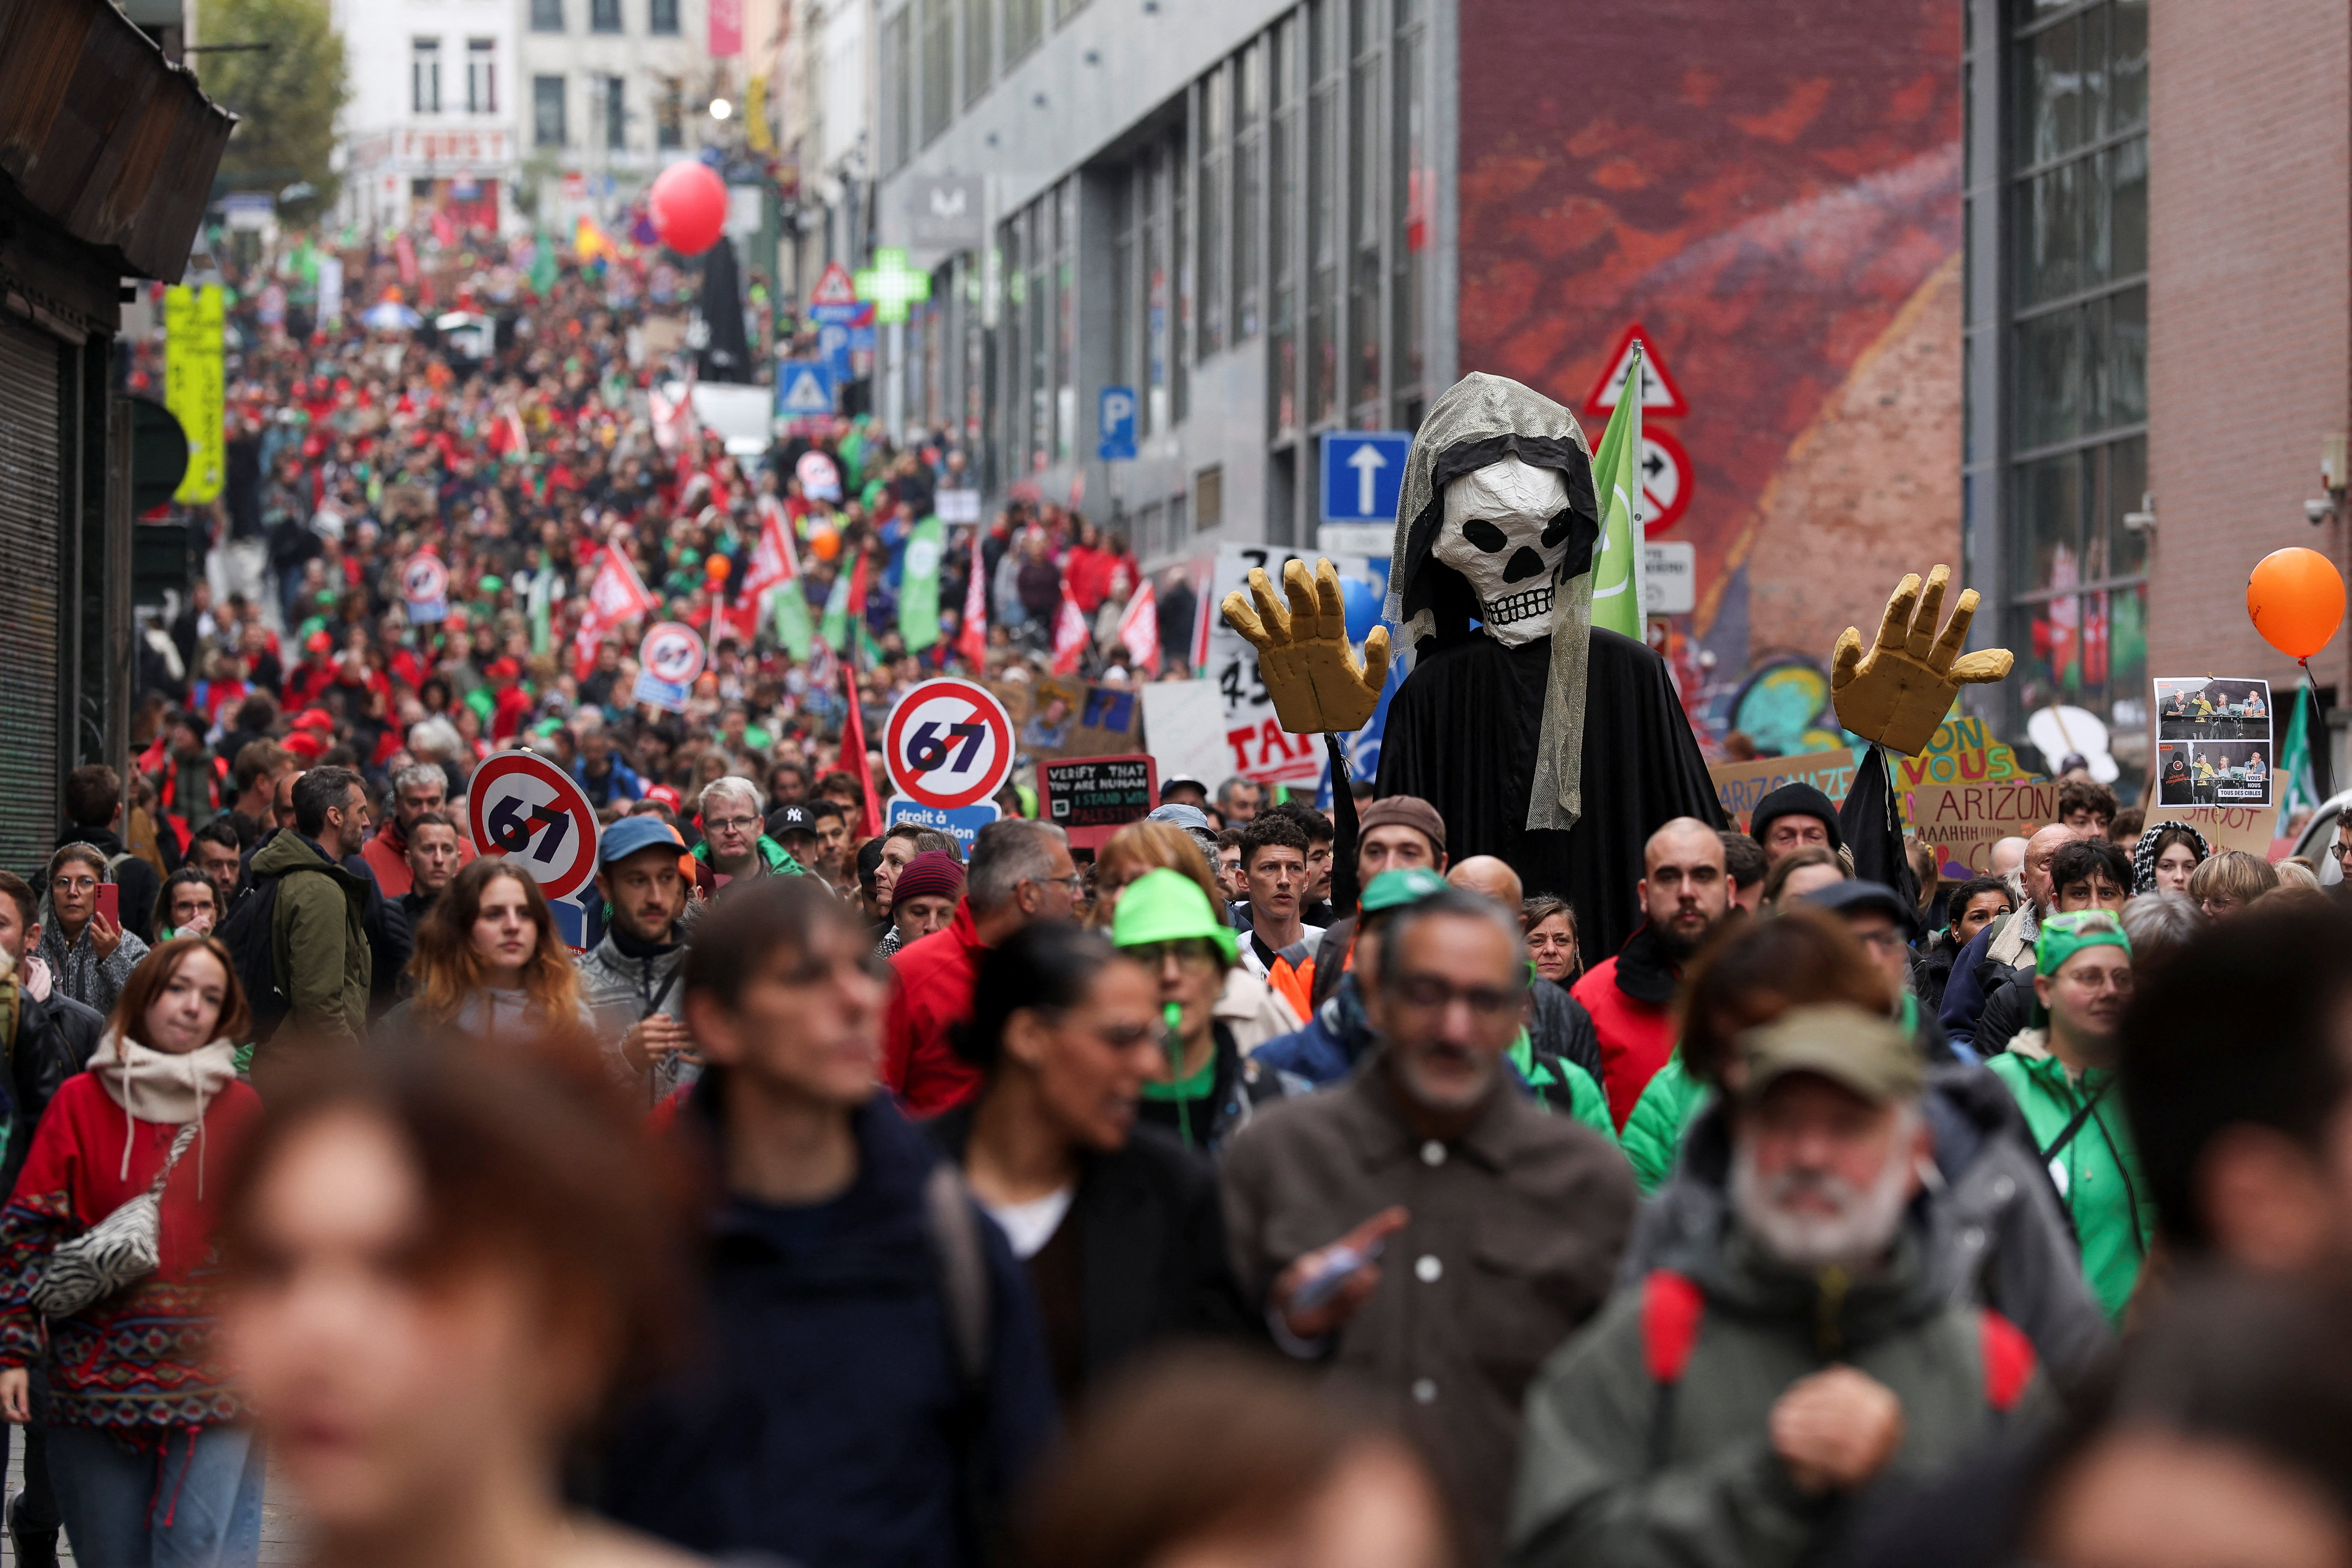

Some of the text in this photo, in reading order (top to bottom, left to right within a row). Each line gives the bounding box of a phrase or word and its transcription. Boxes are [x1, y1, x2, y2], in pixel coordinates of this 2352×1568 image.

[907, 721, 985, 772] 67
[1227, 718, 1315, 770] TA
[1049, 778, 1147, 791] YOU ARE HUMAN
[1108, 764, 1146, 778] THAT
[1901, 747, 2013, 785] VOUS
[896, 809, 947, 825] droit à
[1074, 794, 1080, 806] I
[1082, 791, 1122, 806] STAND
[1935, 785, 2054, 822] ARIZON
[488, 795, 569, 864] 67
